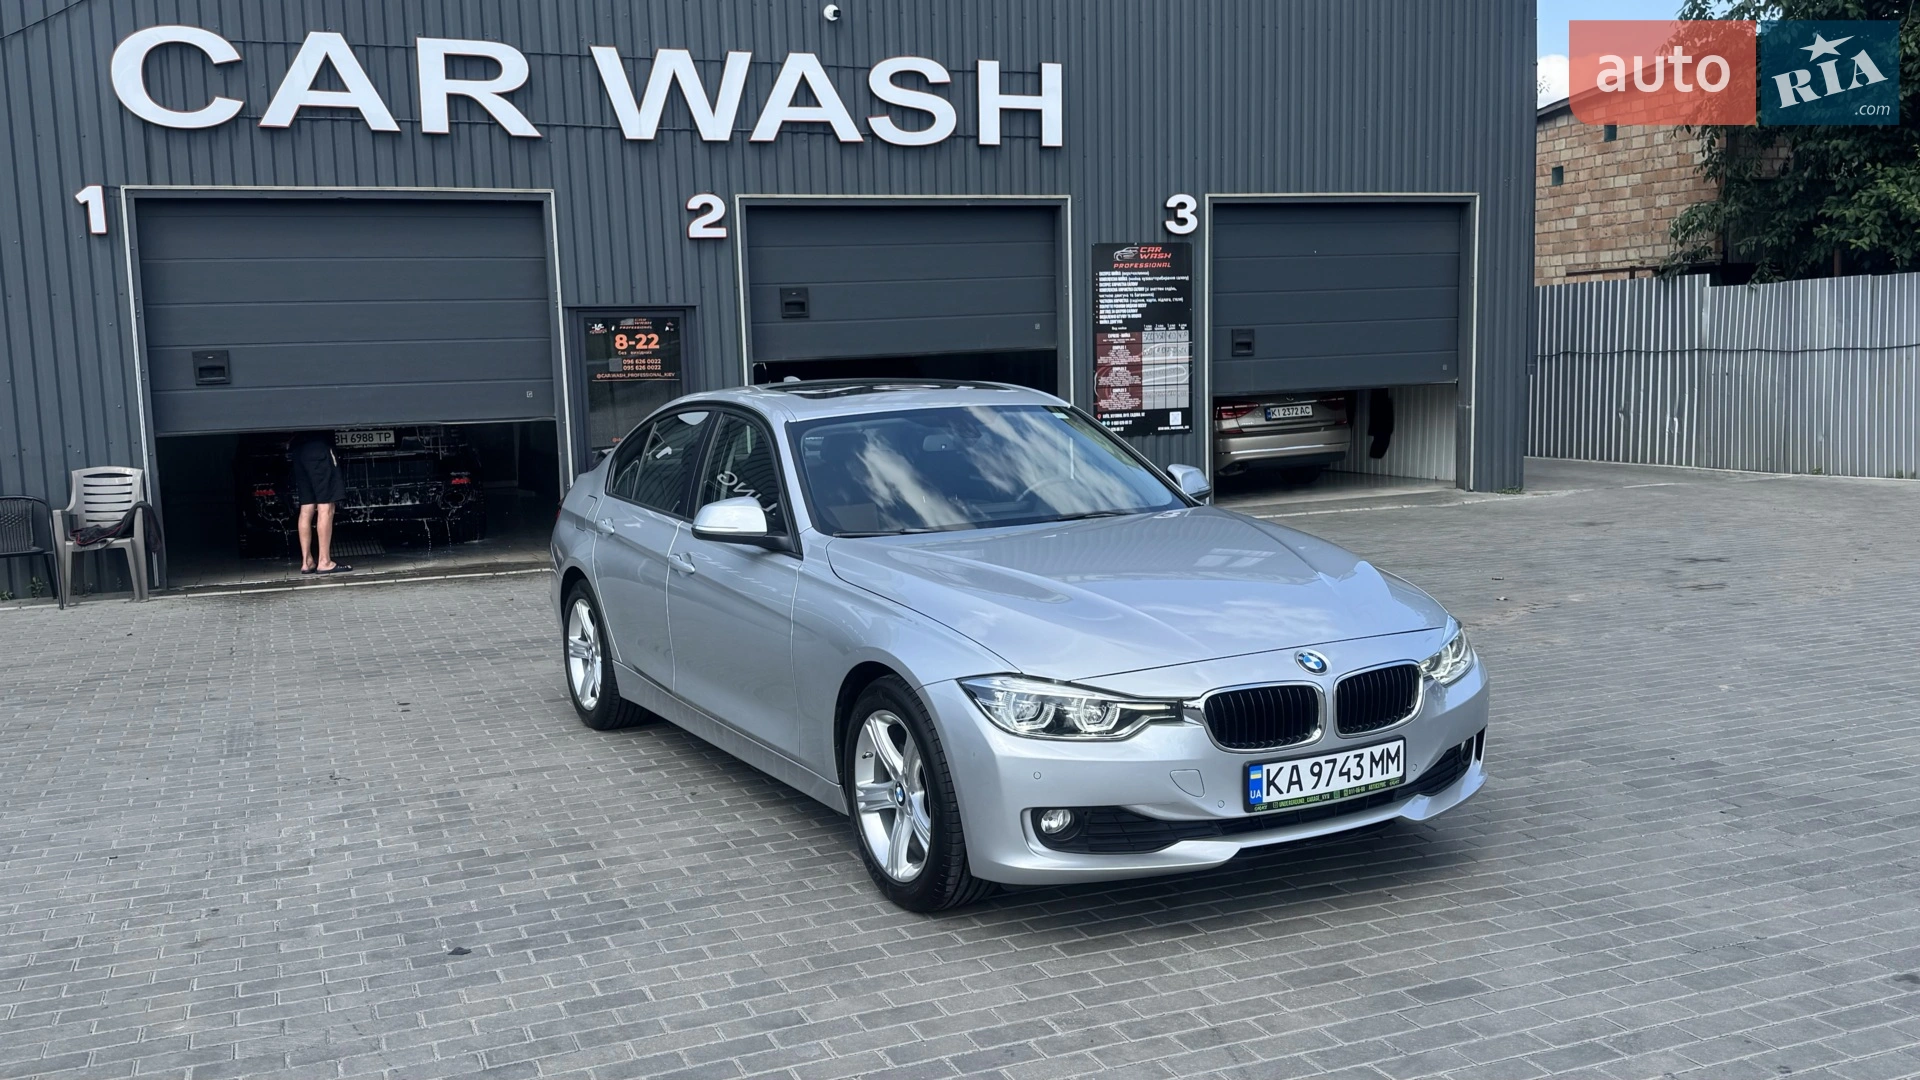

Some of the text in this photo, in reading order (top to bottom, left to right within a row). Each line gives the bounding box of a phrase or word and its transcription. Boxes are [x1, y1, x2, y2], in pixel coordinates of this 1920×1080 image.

[110, 24, 1064, 148] CAR WASH
[75, 184, 108, 235] 1
[686, 192, 728, 240] 2
[1164, 192, 1198, 236] 3
[614, 333, 660, 350] 8-22
[1271, 406, 1311, 417] KI 2372 AC
[350, 432, 374, 443] 6988
[376, 431, 392, 442] TP
[1265, 744, 1401, 797] KA 9743 MM
[1250, 789, 1262, 799] UA
